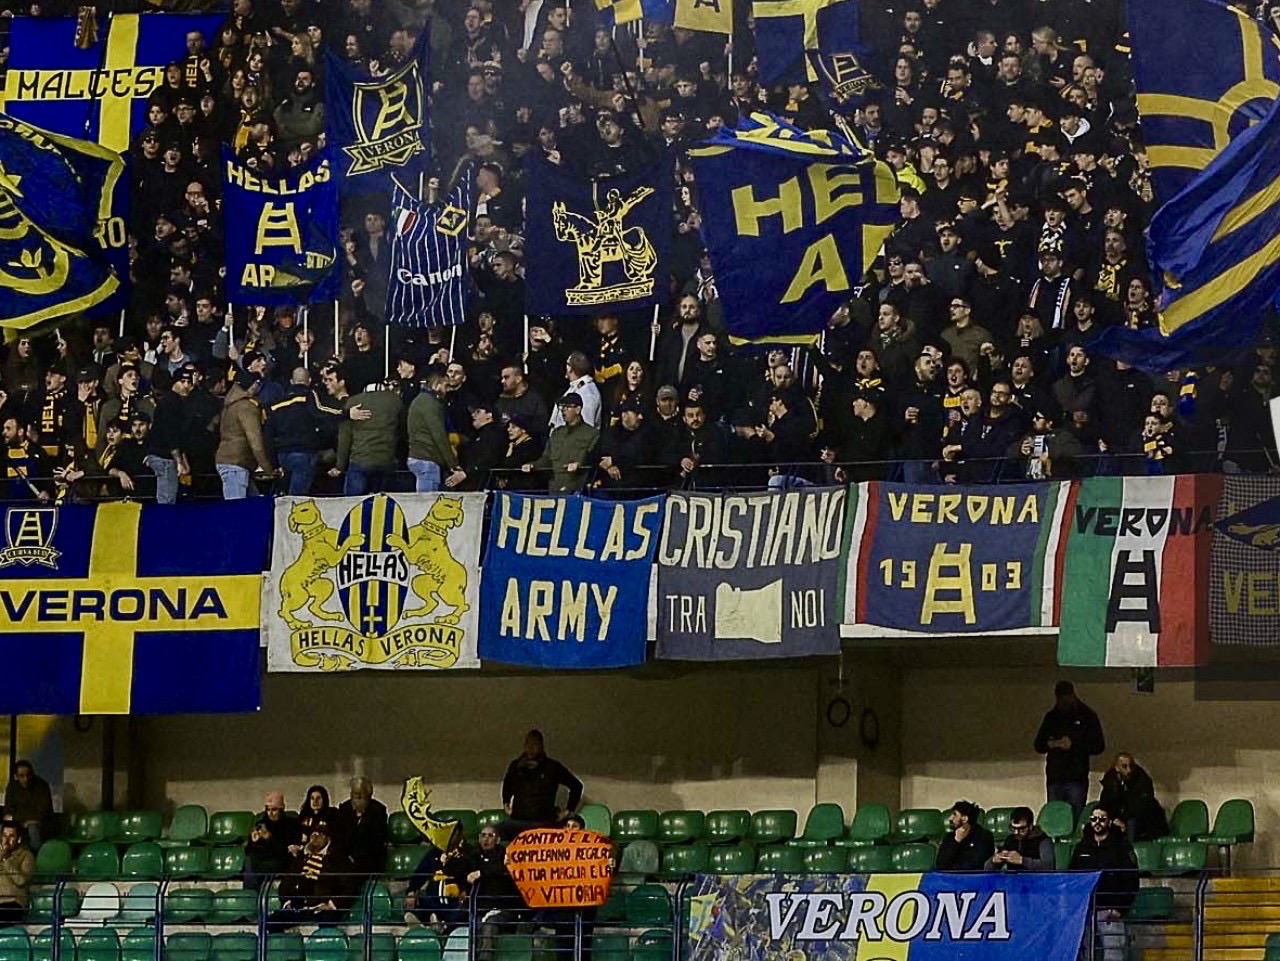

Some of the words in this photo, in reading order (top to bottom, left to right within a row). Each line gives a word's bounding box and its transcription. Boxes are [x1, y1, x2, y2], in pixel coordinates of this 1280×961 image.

[19, 66, 167, 100] MALCES
[227, 160, 330, 195] HELLAS
[397, 263, 462, 286] Canon
[888, 493, 1039, 524] VERONA
[1076, 505, 1215, 538] VERONA
[496, 495, 659, 561] HELLAS
[658, 489, 845, 569] CRISTIANO
[339, 548, 409, 586] HELLAS
[879, 558, 916, 588] 19
[981, 563, 1021, 591] 03
[0, 587, 228, 622] VERONA
[500, 577, 618, 642] ARMY
[666, 594, 707, 633] TRA
[791, 589, 825, 628] NOI
[299, 629, 365, 657] HELLAS
[380, 627, 457, 655] VERONA
[513, 870, 525, 882] LA
[528, 868, 547, 881] TUA
[551, 865, 586, 880] MAGLIA
[541, 885, 605, 904] VITTORIA
[765, 891, 1013, 940] VERONA
